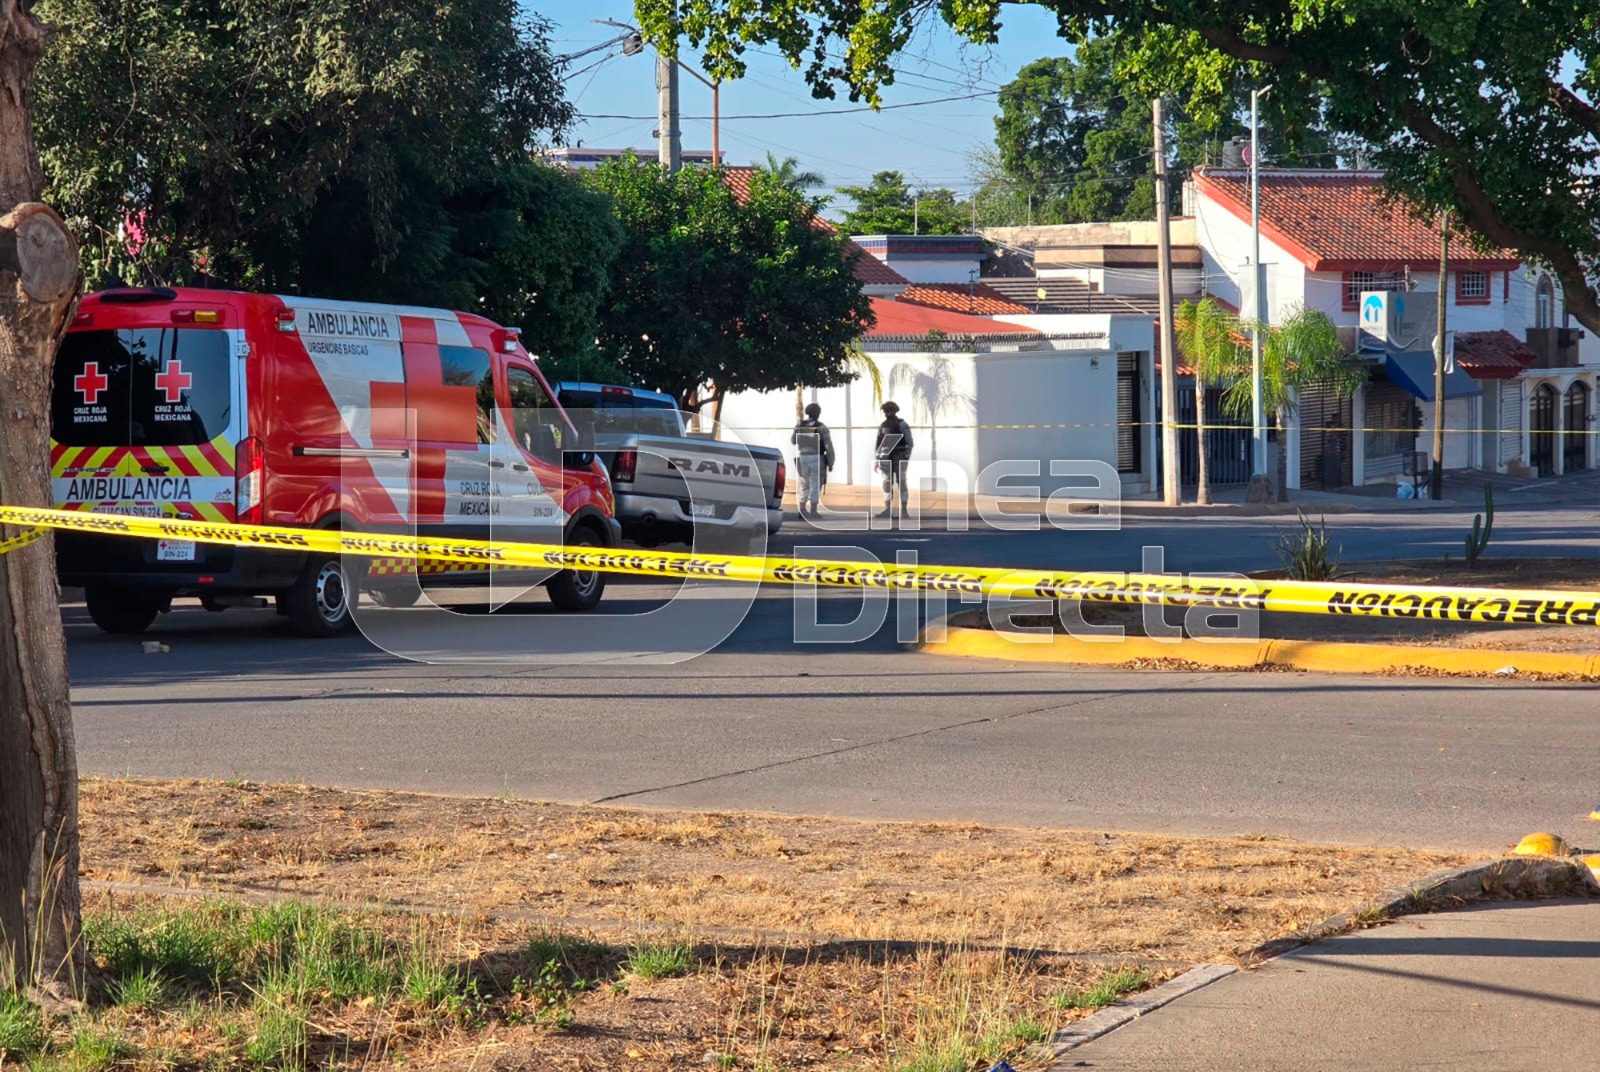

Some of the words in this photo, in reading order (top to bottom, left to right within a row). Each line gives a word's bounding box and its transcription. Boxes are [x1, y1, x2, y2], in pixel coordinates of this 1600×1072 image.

[307, 312, 390, 338] AMBULANCIA
[307, 341, 342, 355] URGENCIAS
[74, 407, 90, 415] CRUZ
[92, 406, 107, 414] ROJA
[154, 405, 172, 413] CRUZ
[174, 405, 191, 413] ROJA
[667, 457, 750, 478] RAM
[67, 478, 192, 501] AMBULANCIA
[460, 482, 480, 496] CRUZ
[459, 502, 501, 516] MEXICANA
